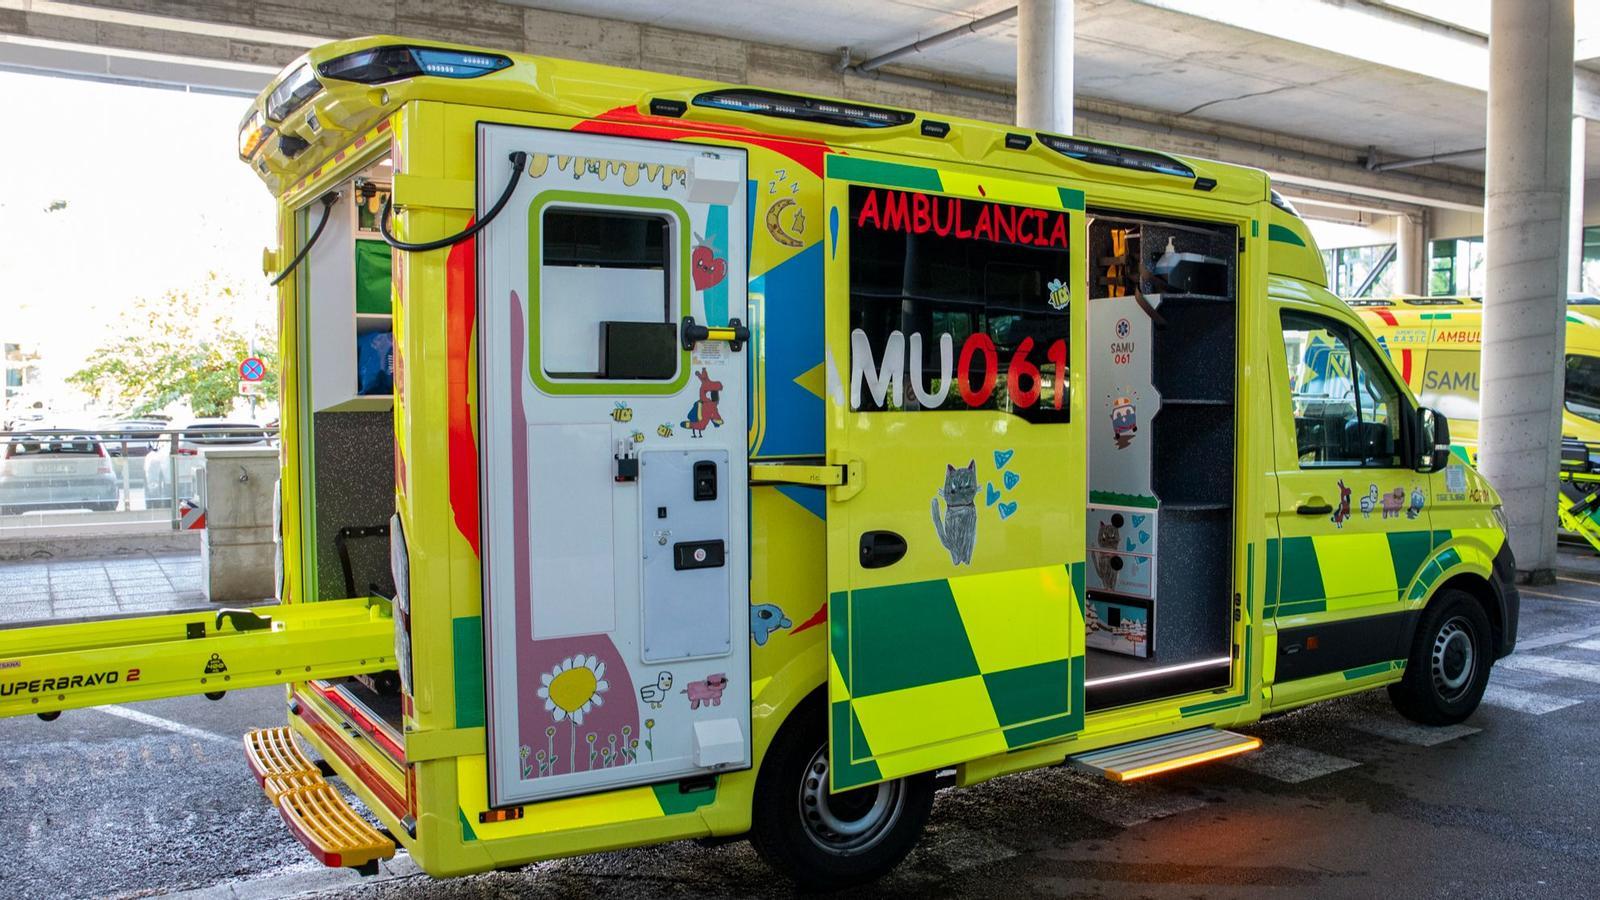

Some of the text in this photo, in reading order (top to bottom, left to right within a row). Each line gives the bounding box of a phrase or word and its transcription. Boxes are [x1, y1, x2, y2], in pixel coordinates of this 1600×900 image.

[1110, 342, 1135, 353] SAMU
[1114, 353, 1130, 365] 061
[126, 668, 141, 682] 2
